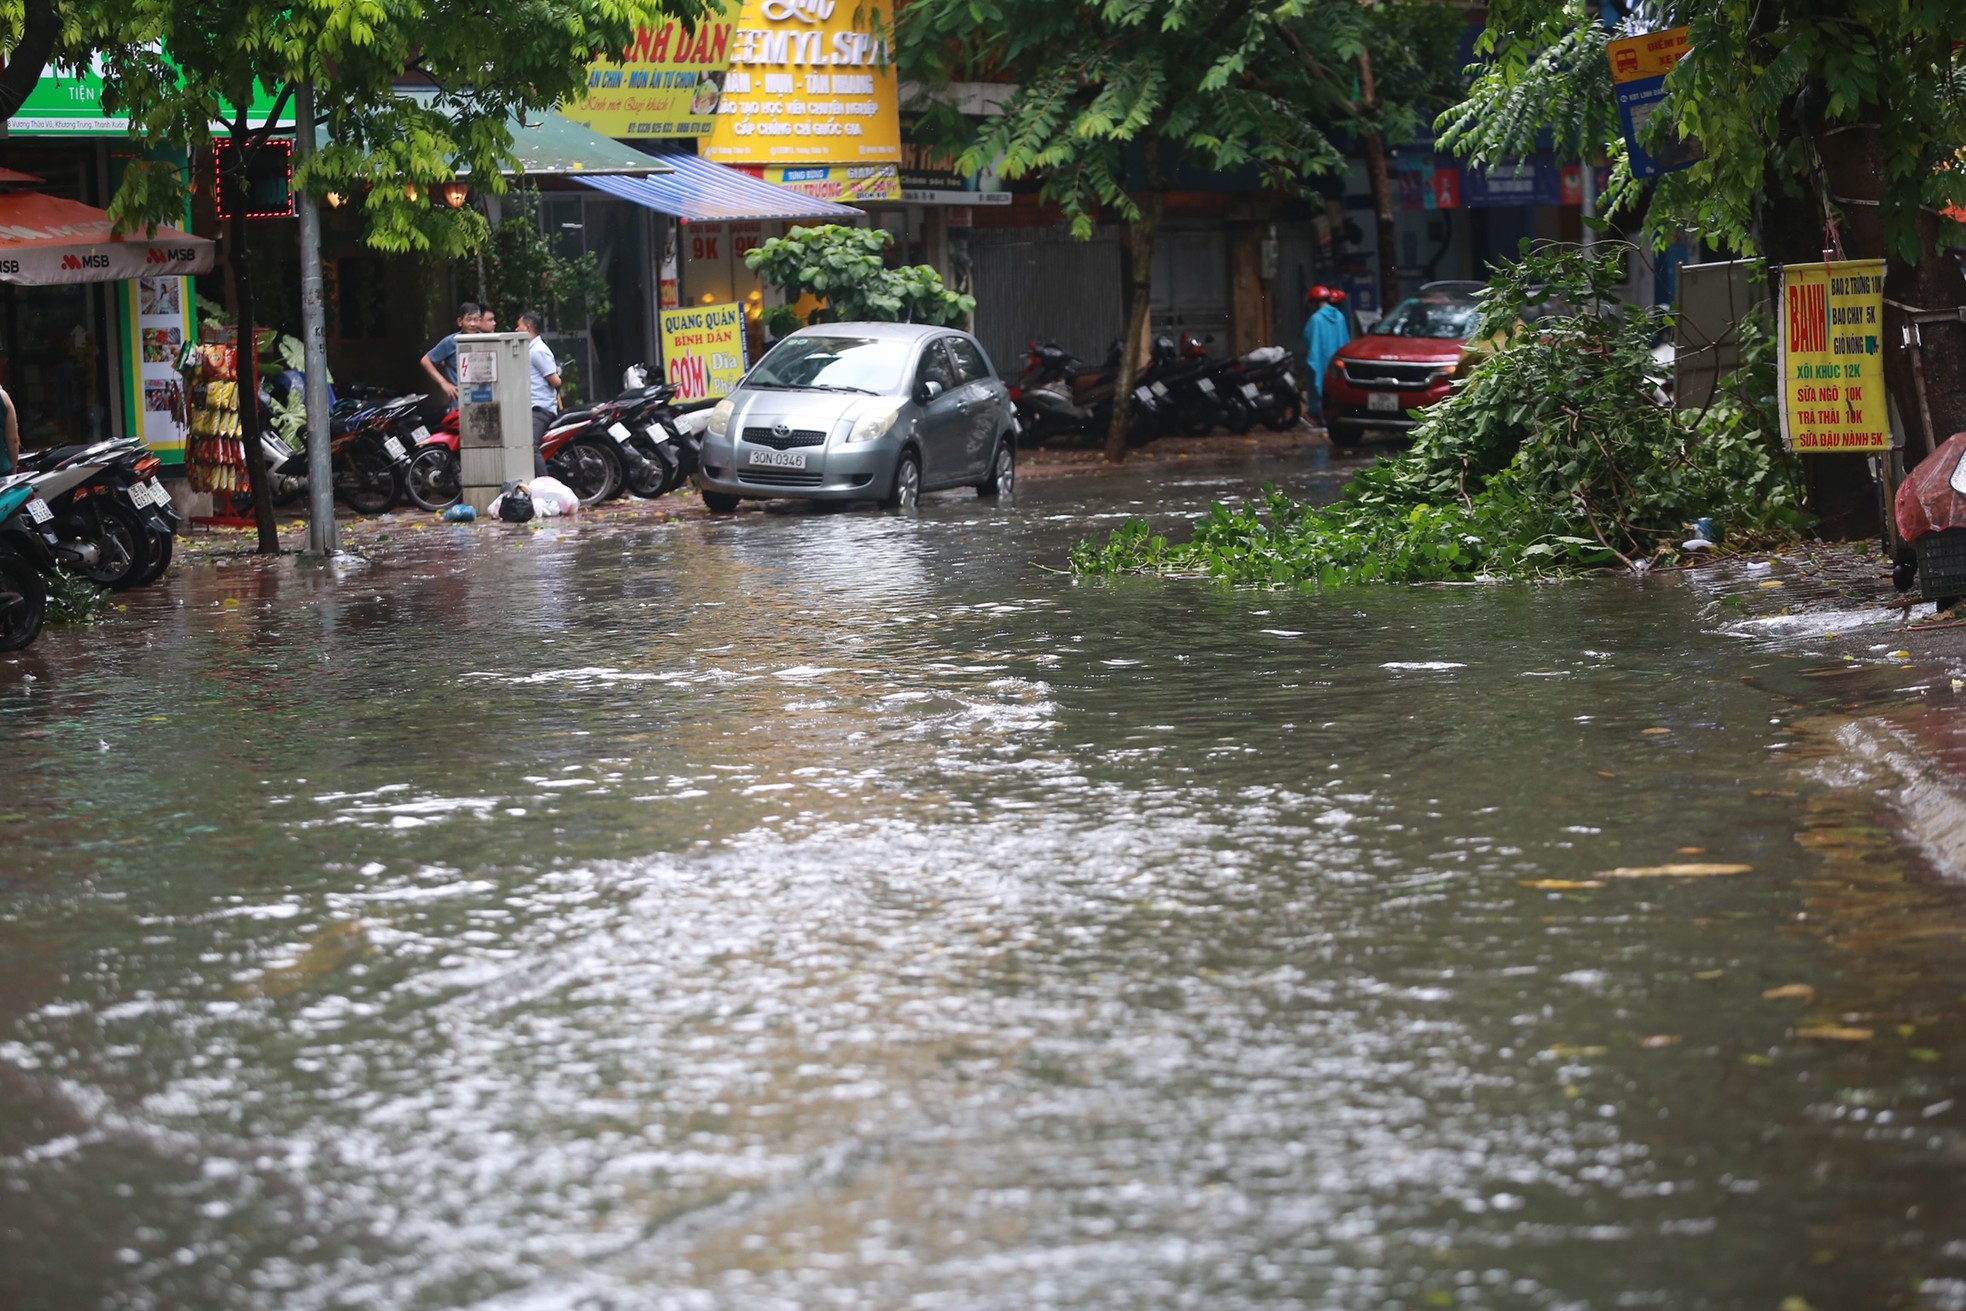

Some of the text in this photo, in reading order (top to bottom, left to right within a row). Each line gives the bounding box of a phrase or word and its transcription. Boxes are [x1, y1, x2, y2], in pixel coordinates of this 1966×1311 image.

[624, 22, 673, 63] NH
[68, 85, 94, 102] TIỆN
[82, 255, 109, 268] MSB
[167, 249, 195, 262] MSB
[0, 260, 19, 273] SB
[1832, 278, 1844, 295] BAO
[665, 307, 736, 334] QUANG QUÁN
[1832, 306, 1876, 325] BAO CHAY 5K
[674, 329, 732, 347] BÌNH DÂN
[670, 348, 705, 399] CƠM
[1797, 362, 1860, 379] XÔI KHÚC 12K
[1797, 385, 1816, 402] SỮA
[1845, 387, 1862, 401] 10K
[1800, 430, 1818, 447] SỮA
[1820, 430, 1840, 450] ĐẬU
[1871, 432, 1883, 446] 5K
[753, 451, 802, 467] 30N-0346
